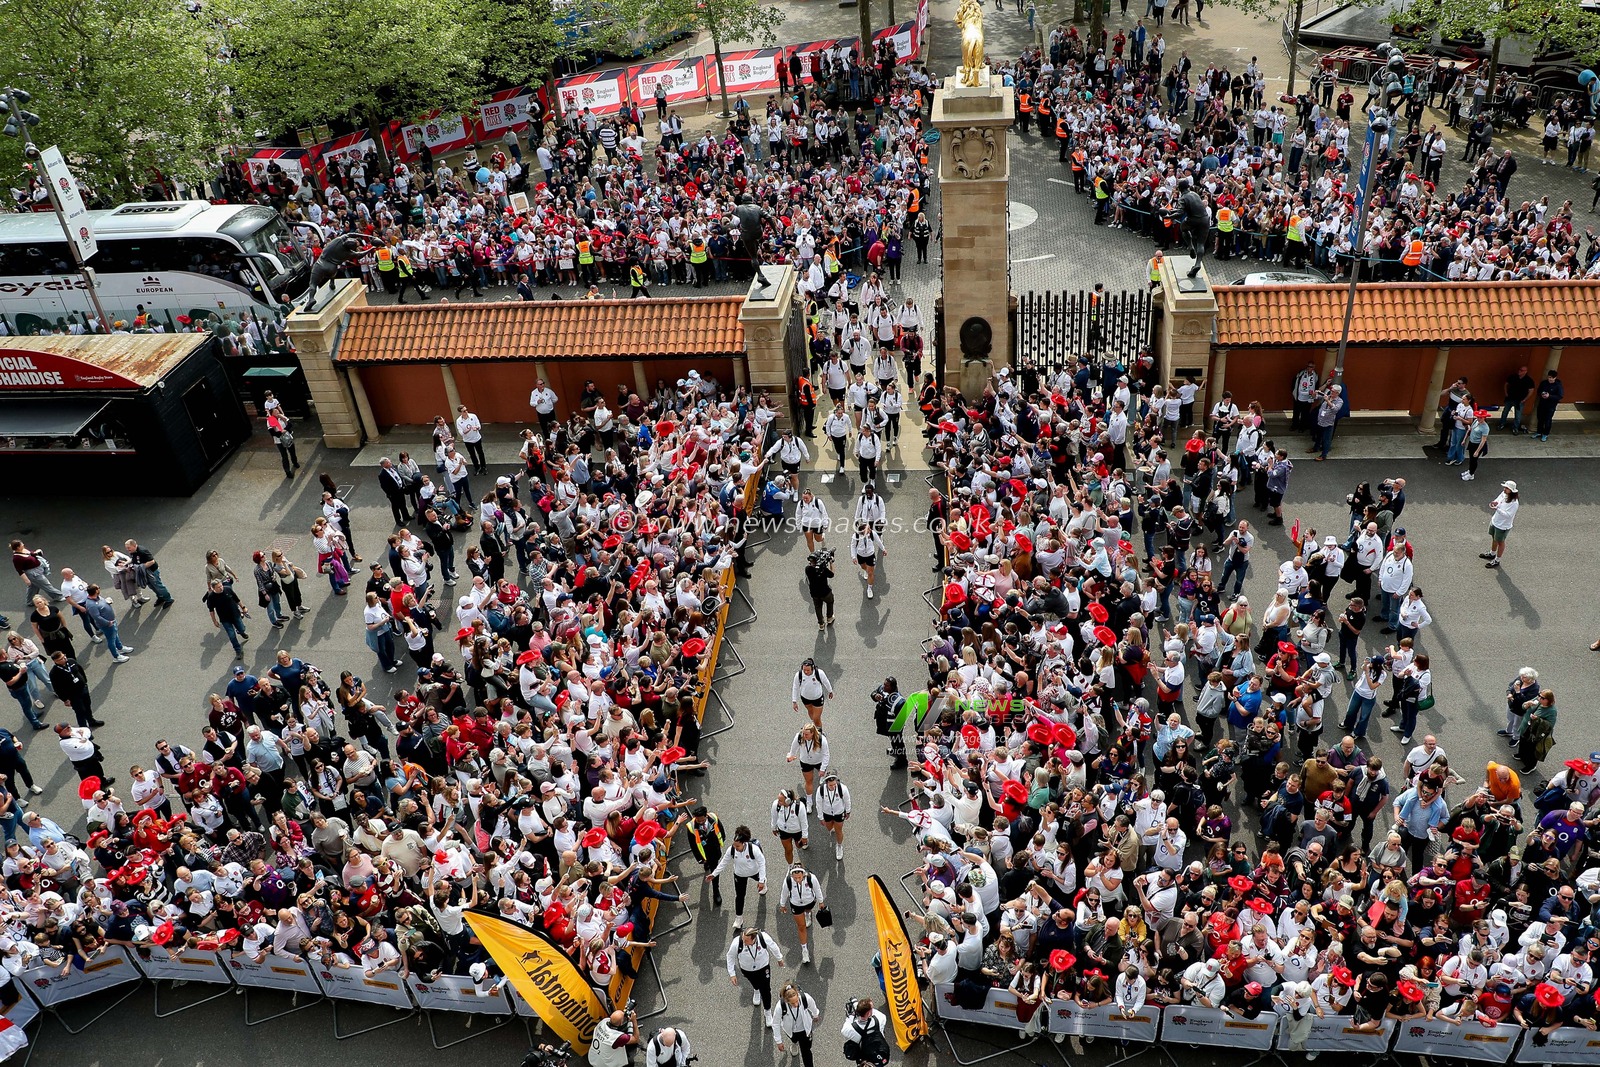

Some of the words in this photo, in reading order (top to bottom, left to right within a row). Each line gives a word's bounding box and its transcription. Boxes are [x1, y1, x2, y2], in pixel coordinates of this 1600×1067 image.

[642, 76, 656, 84] RED
[562, 90, 577, 98] RED
[484, 106, 499, 116] RED
[69, 210, 80, 219] Allianz
